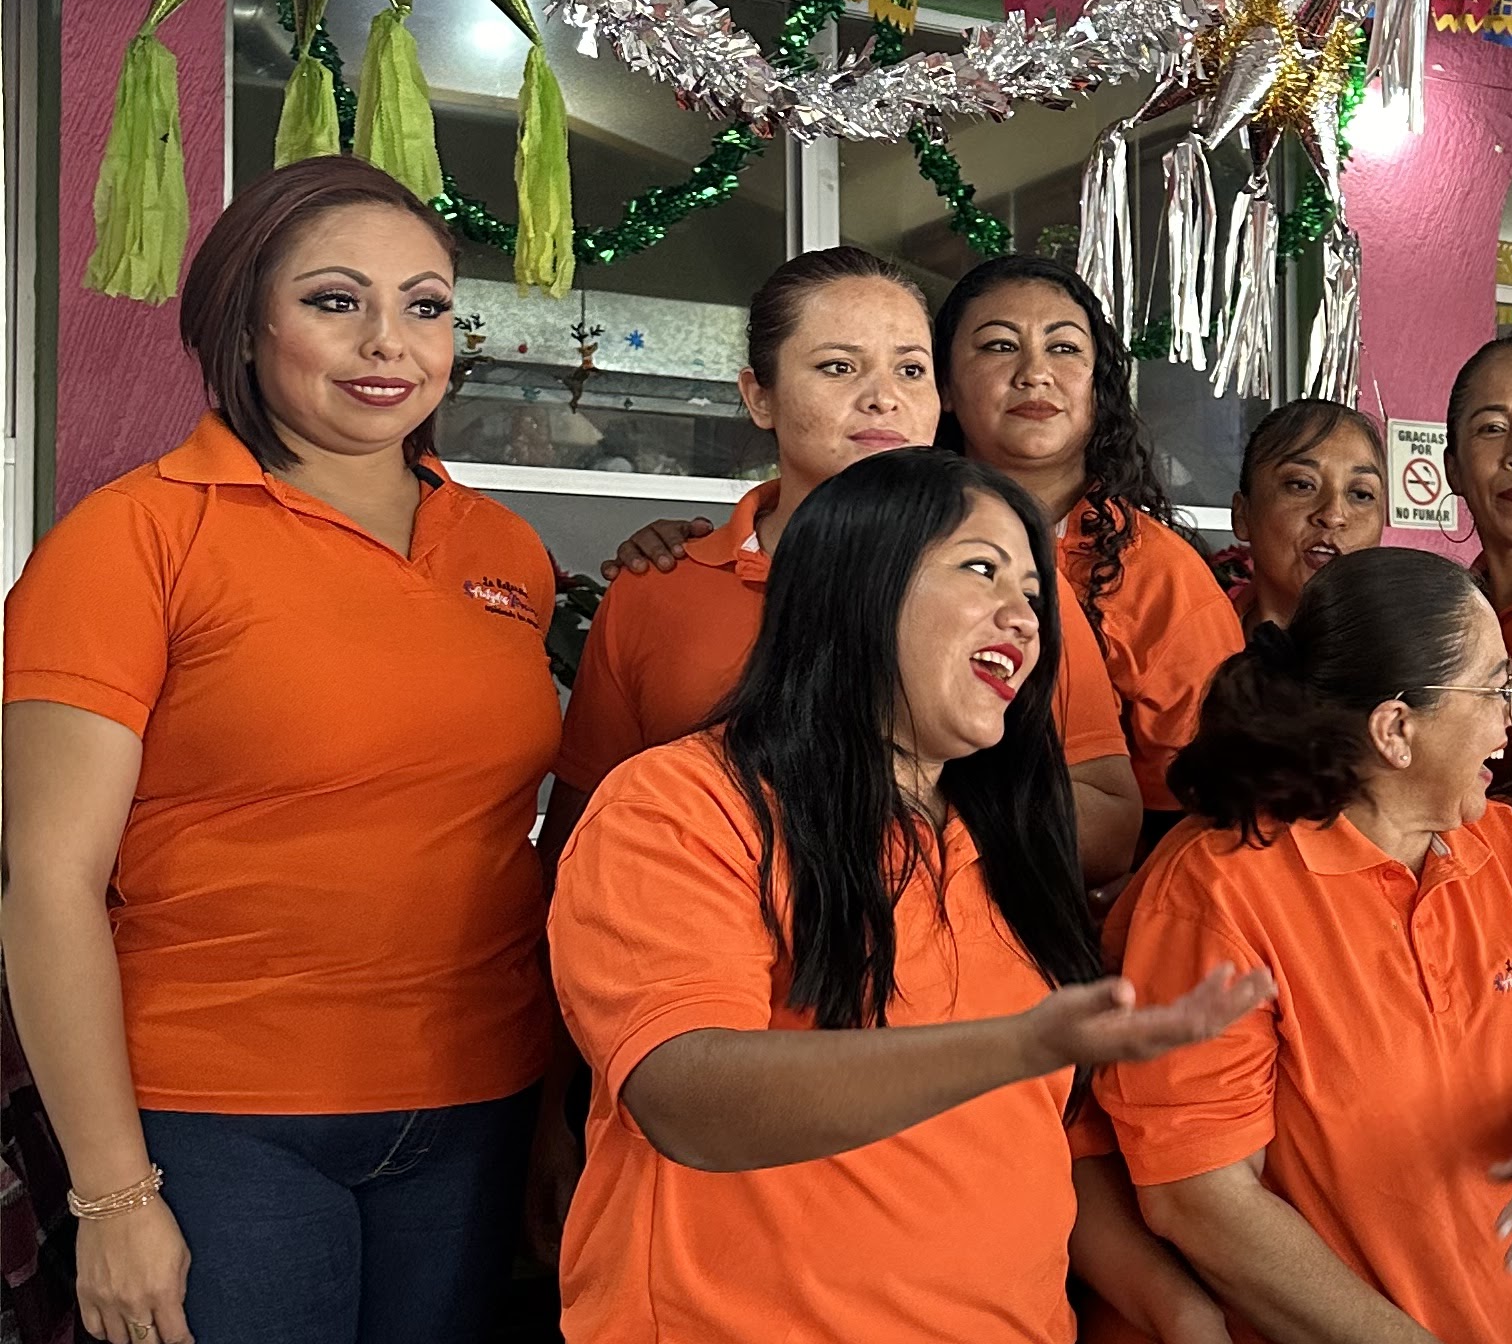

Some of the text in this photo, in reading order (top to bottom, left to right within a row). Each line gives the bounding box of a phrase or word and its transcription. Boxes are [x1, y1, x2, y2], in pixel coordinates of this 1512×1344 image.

[1398, 430, 1445, 444] GRACIAS
[1411, 443, 1432, 455] POR
[1395, 507, 1450, 521] NO FUMAR
